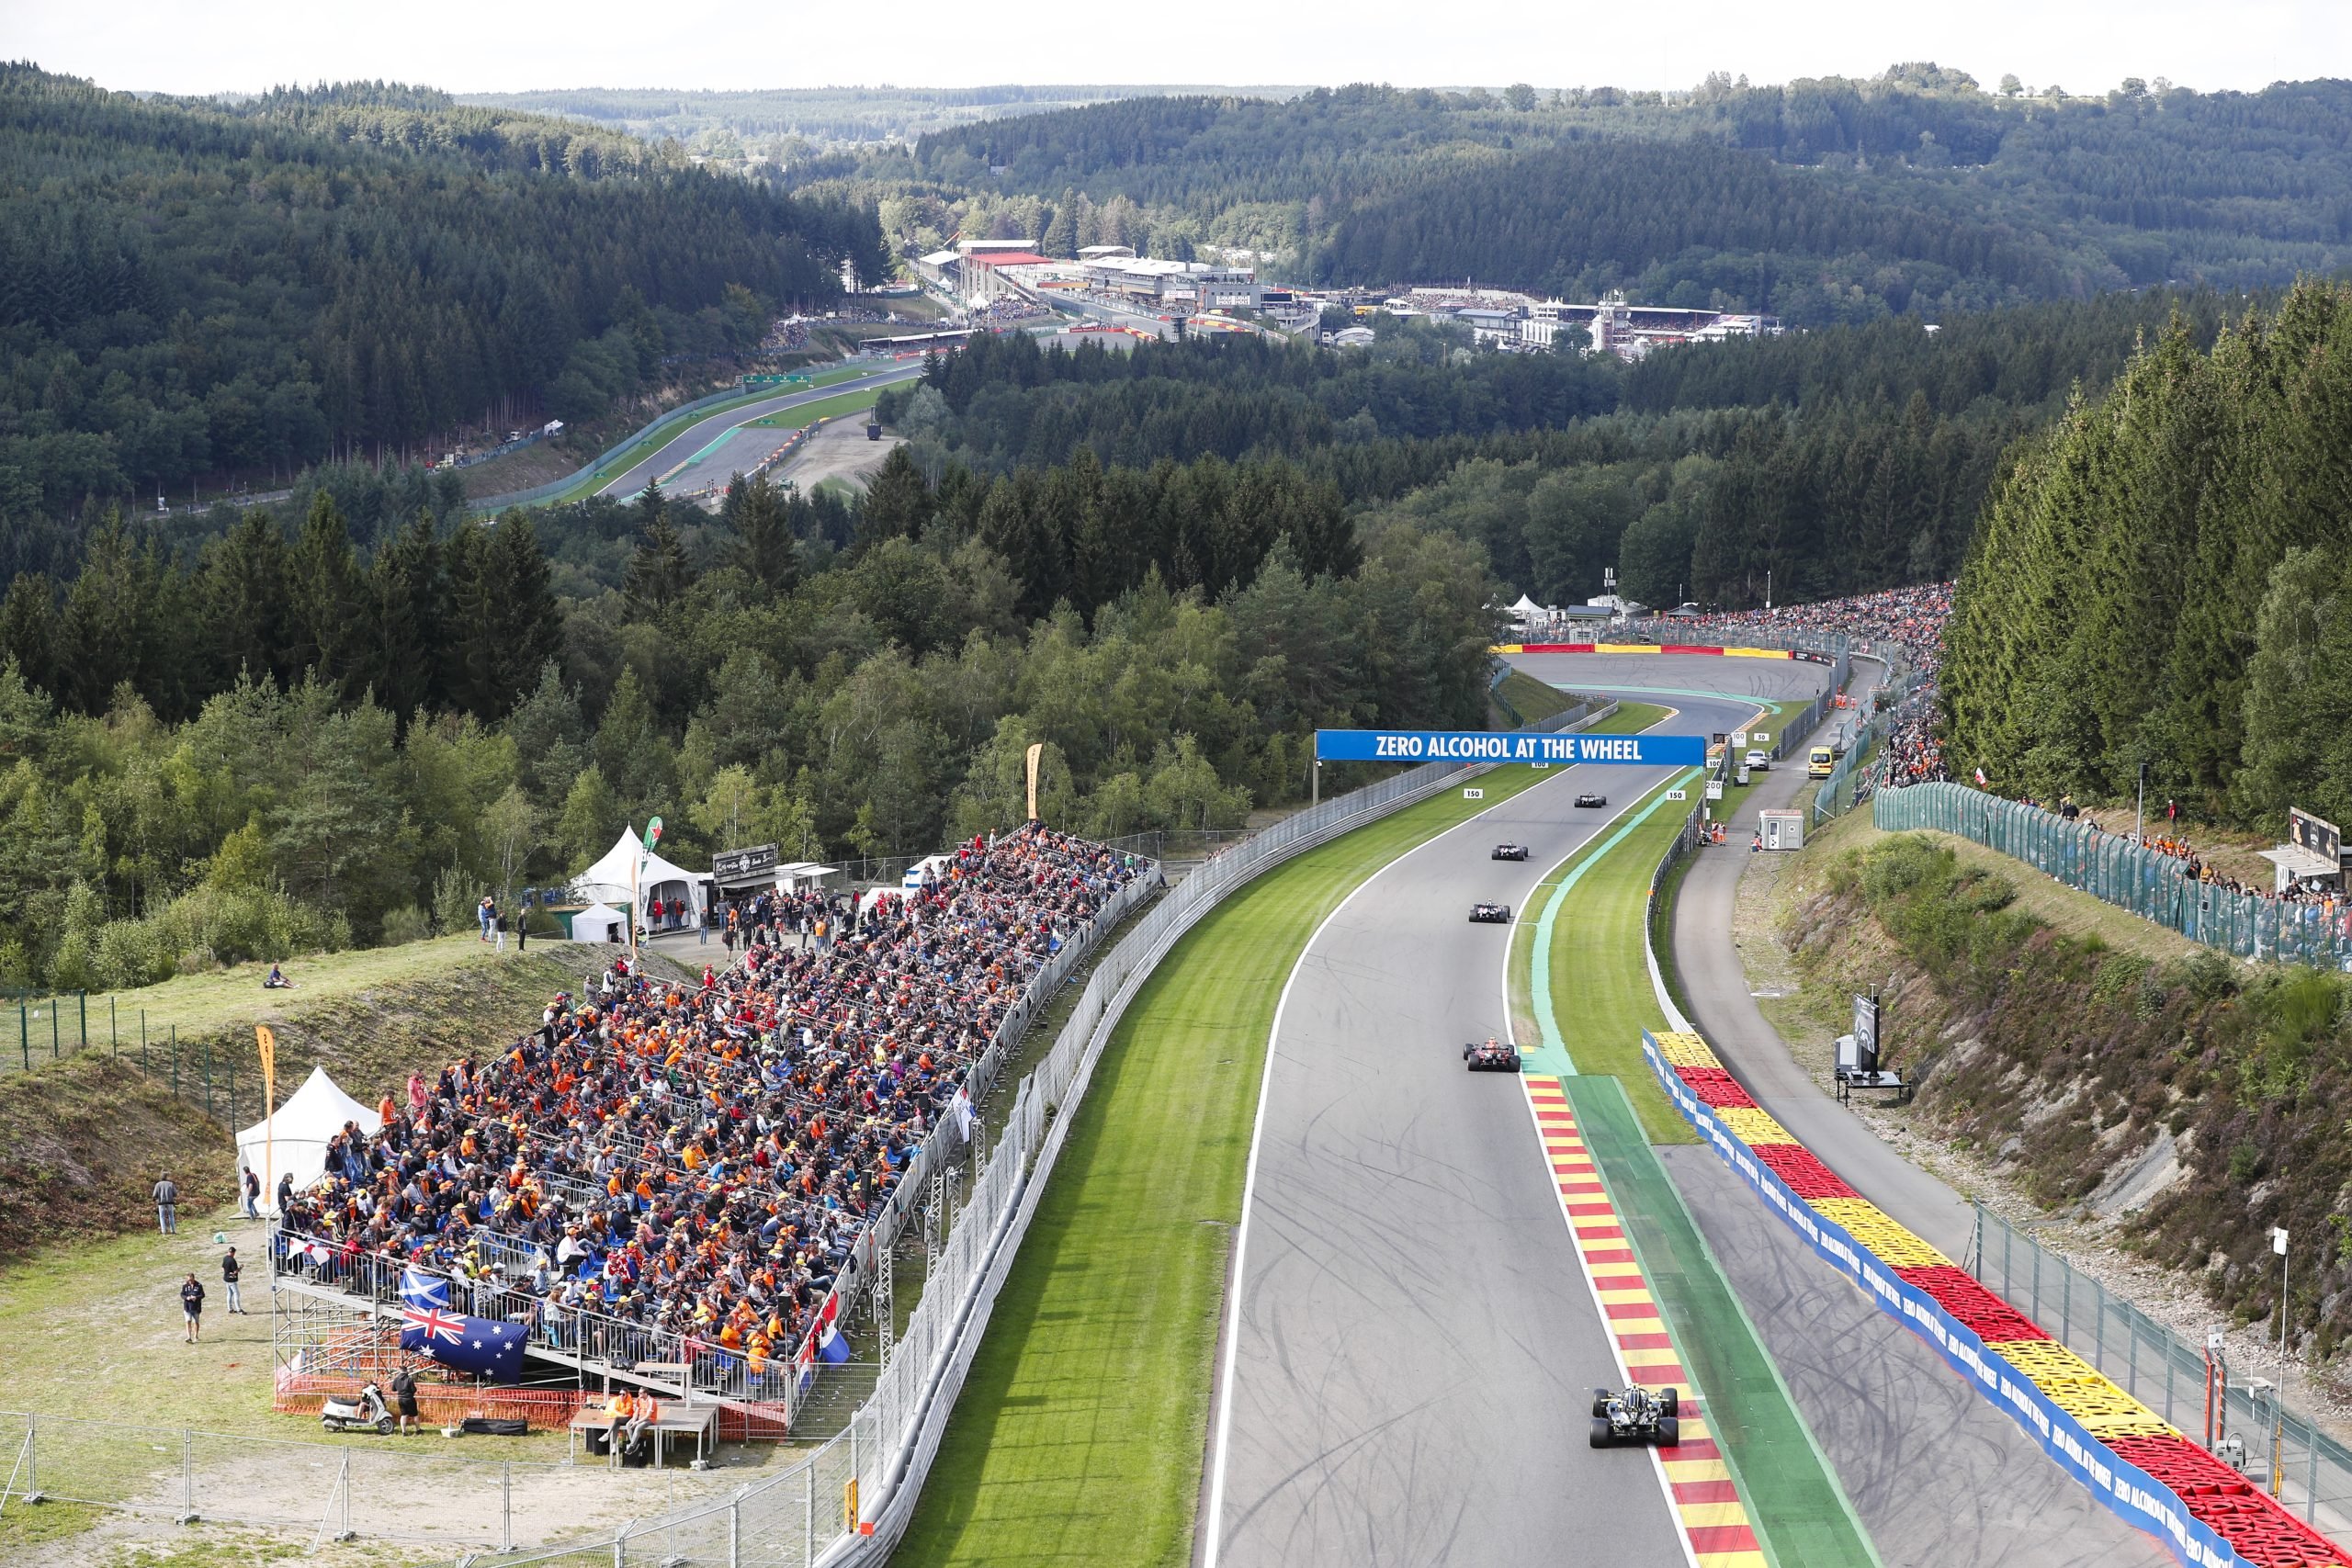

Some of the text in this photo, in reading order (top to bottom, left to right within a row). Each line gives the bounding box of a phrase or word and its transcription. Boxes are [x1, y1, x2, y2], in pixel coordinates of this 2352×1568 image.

[1376, 736, 1643, 761] ZERO ALCOHOL AT THE WHEEL
[1706, 782, 1721, 790] 200
[2114, 1476, 2131, 1504] ZERO
